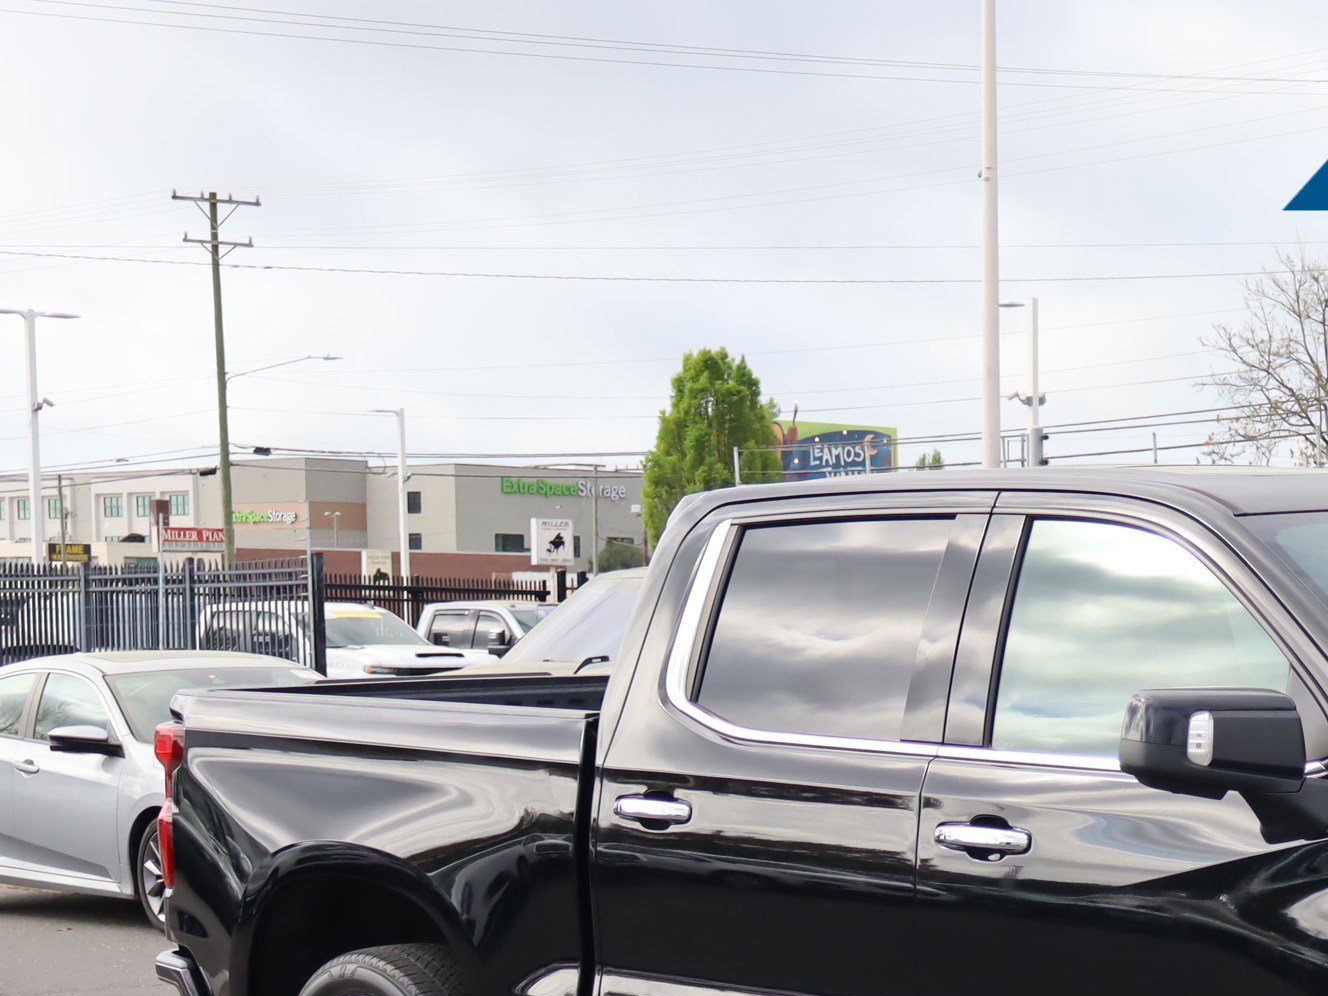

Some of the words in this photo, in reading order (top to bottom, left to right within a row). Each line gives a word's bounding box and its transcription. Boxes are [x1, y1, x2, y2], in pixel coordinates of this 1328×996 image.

[810, 443, 864, 466] LEAMOS
[163, 530, 198, 541] MILLER
[55, 544, 85, 554] FAME
